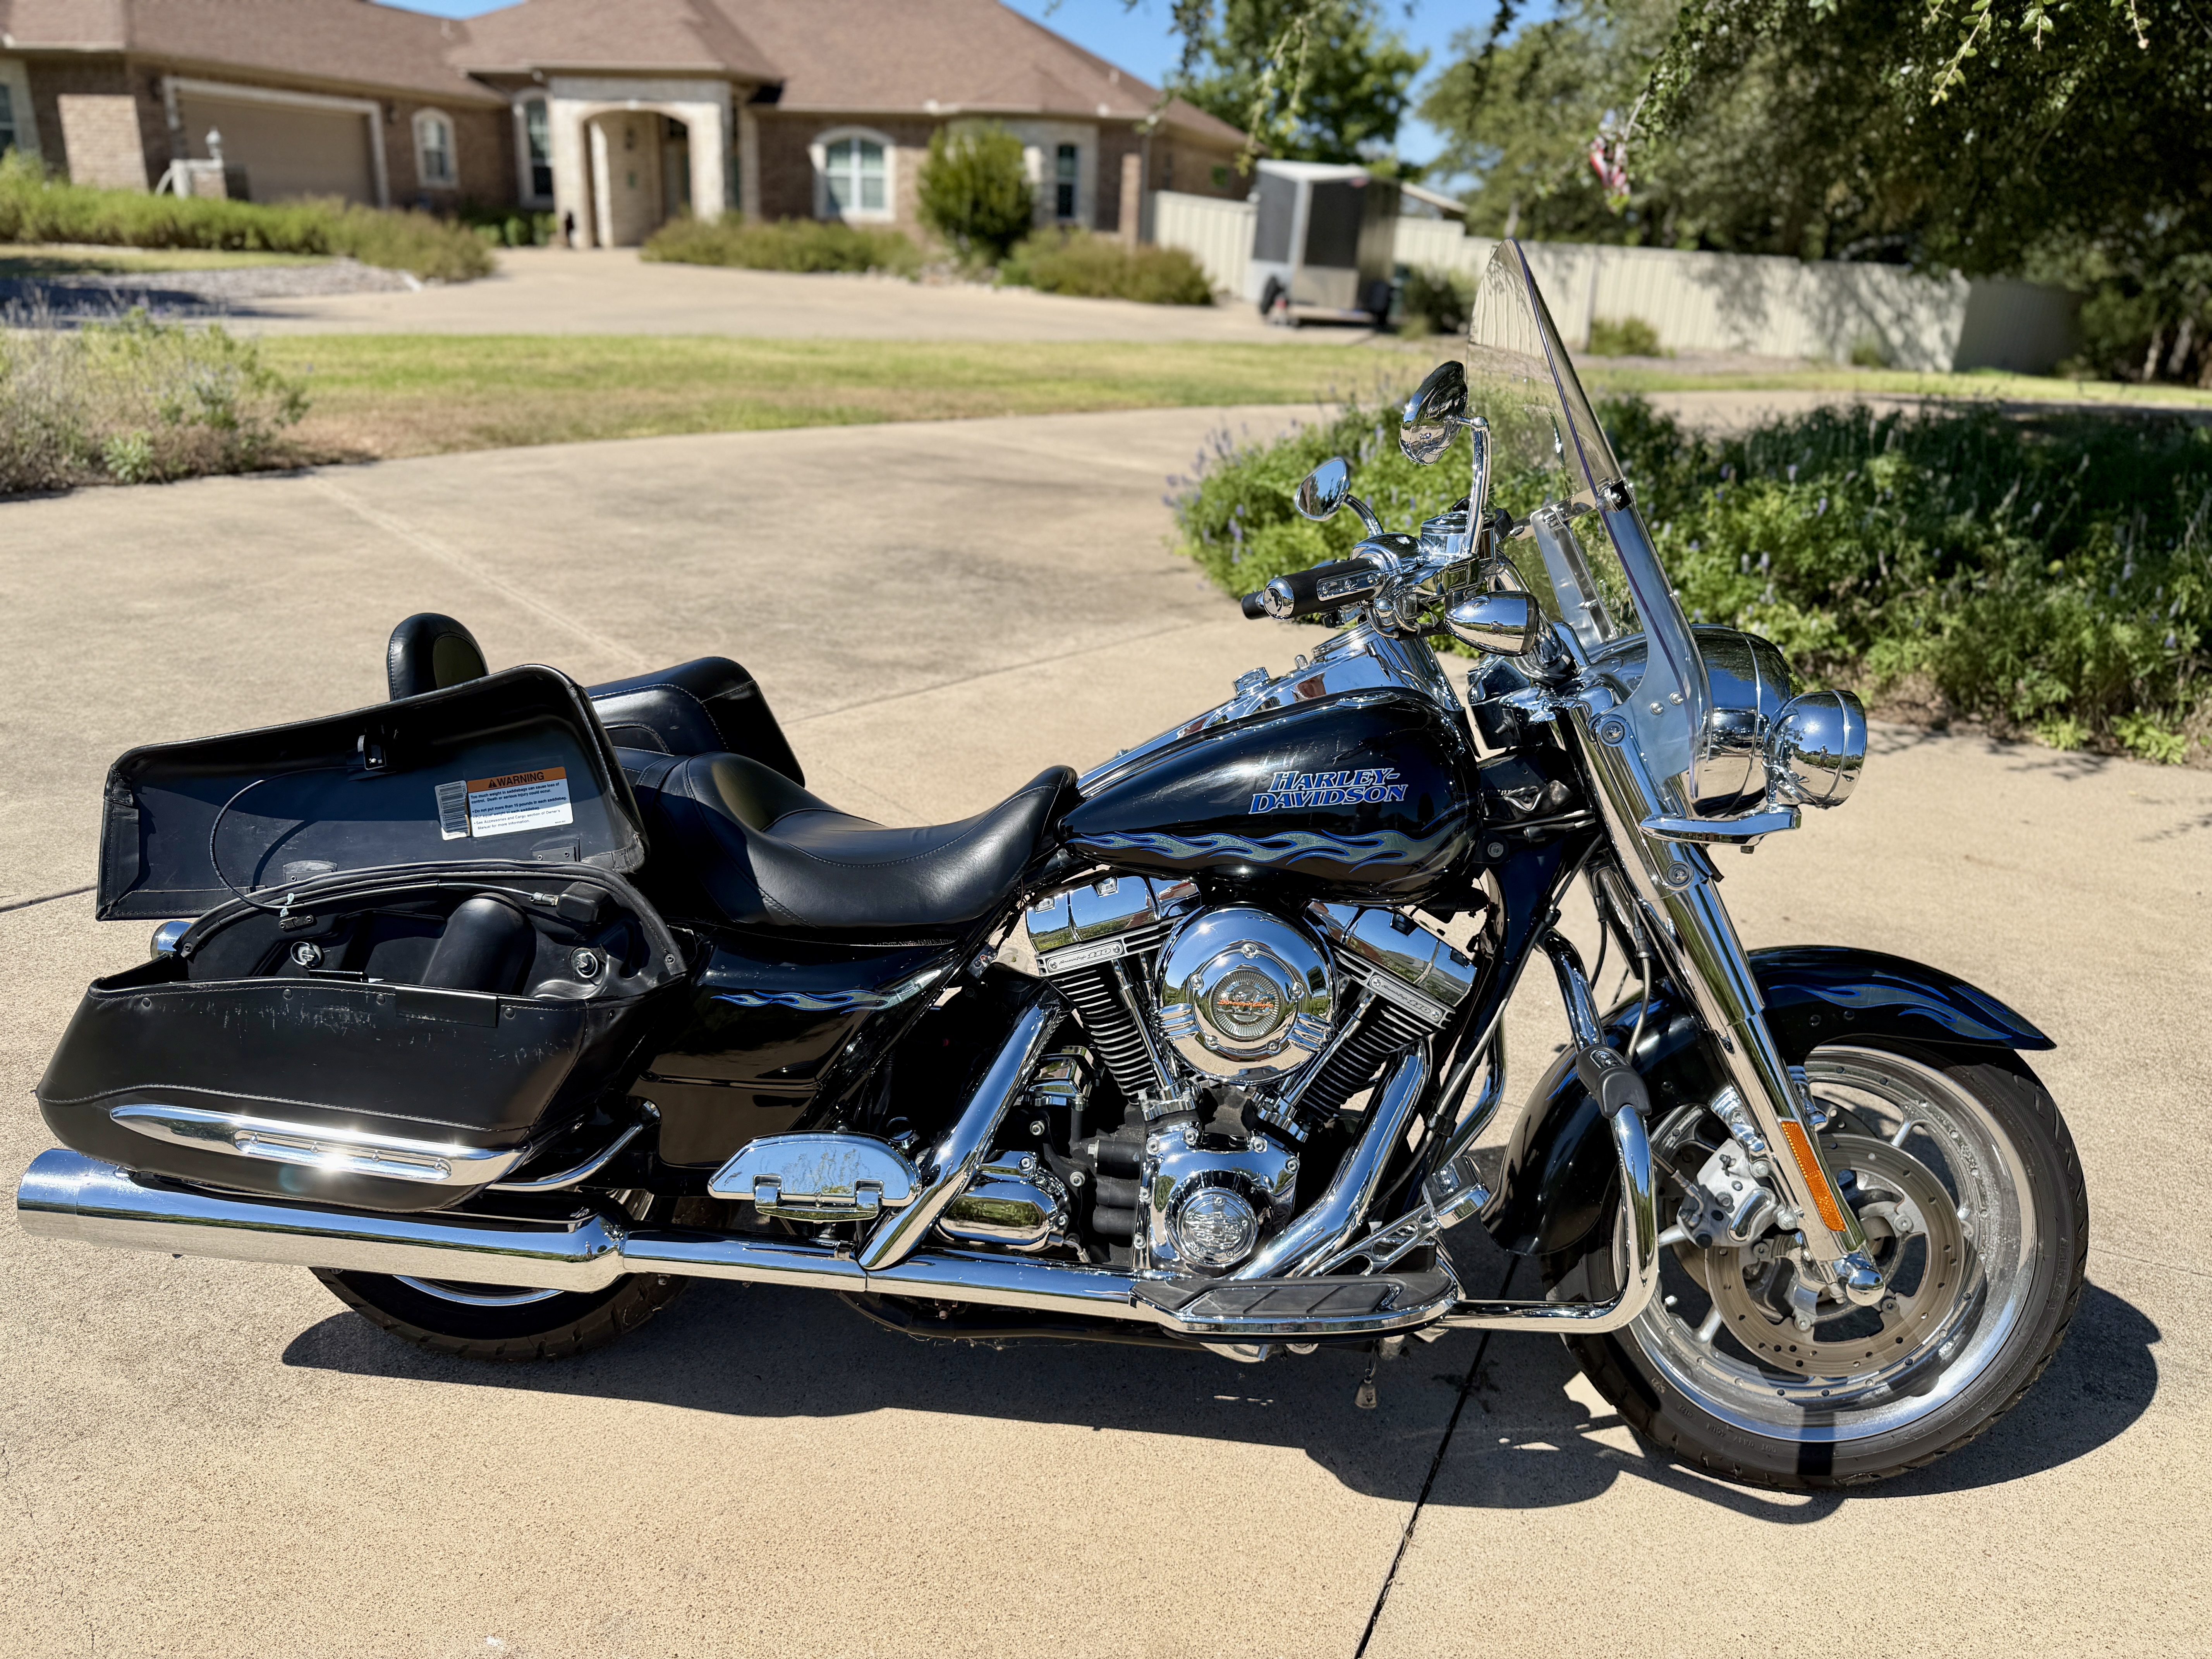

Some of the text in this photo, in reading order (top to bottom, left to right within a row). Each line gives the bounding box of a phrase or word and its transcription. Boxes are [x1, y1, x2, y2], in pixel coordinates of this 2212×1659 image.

[496, 772, 544, 787] WARNING
[1267, 768, 1400, 792] HARLEY-
[1248, 784, 1408, 814] DAVIDSON
